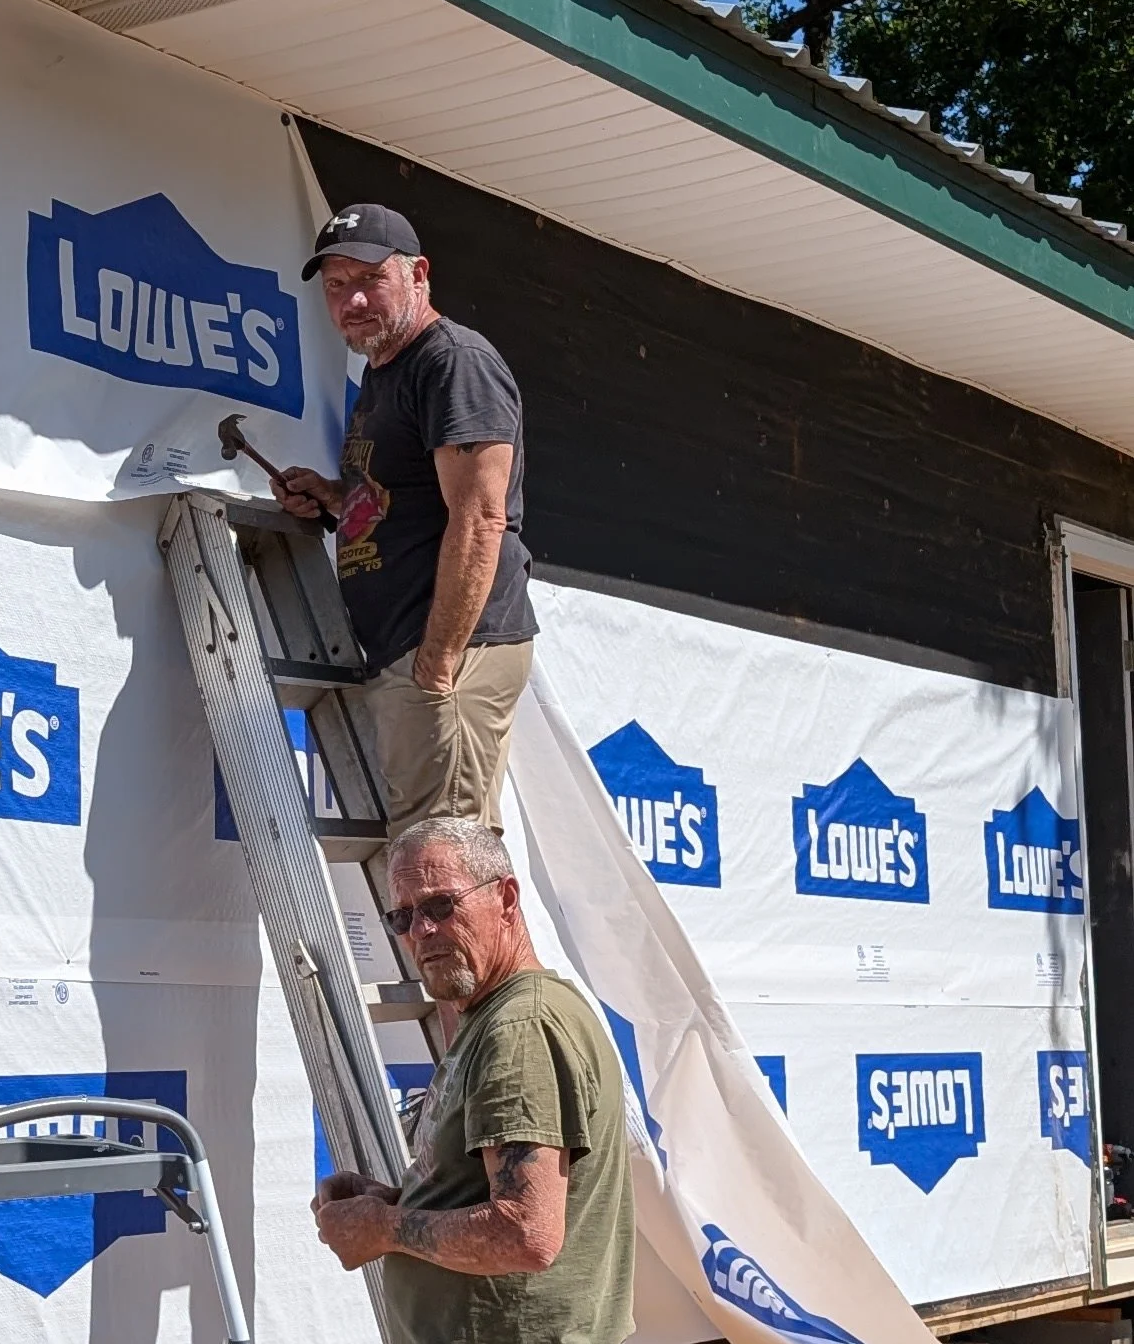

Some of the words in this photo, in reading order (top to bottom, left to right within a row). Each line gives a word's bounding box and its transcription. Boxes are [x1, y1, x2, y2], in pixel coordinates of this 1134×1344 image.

[59, 238, 280, 387] LOWE'S
[616, 791, 704, 869] WE'S
[807, 809, 918, 888] LOWE'S
[869, 1069, 973, 1140] LOWE'S
